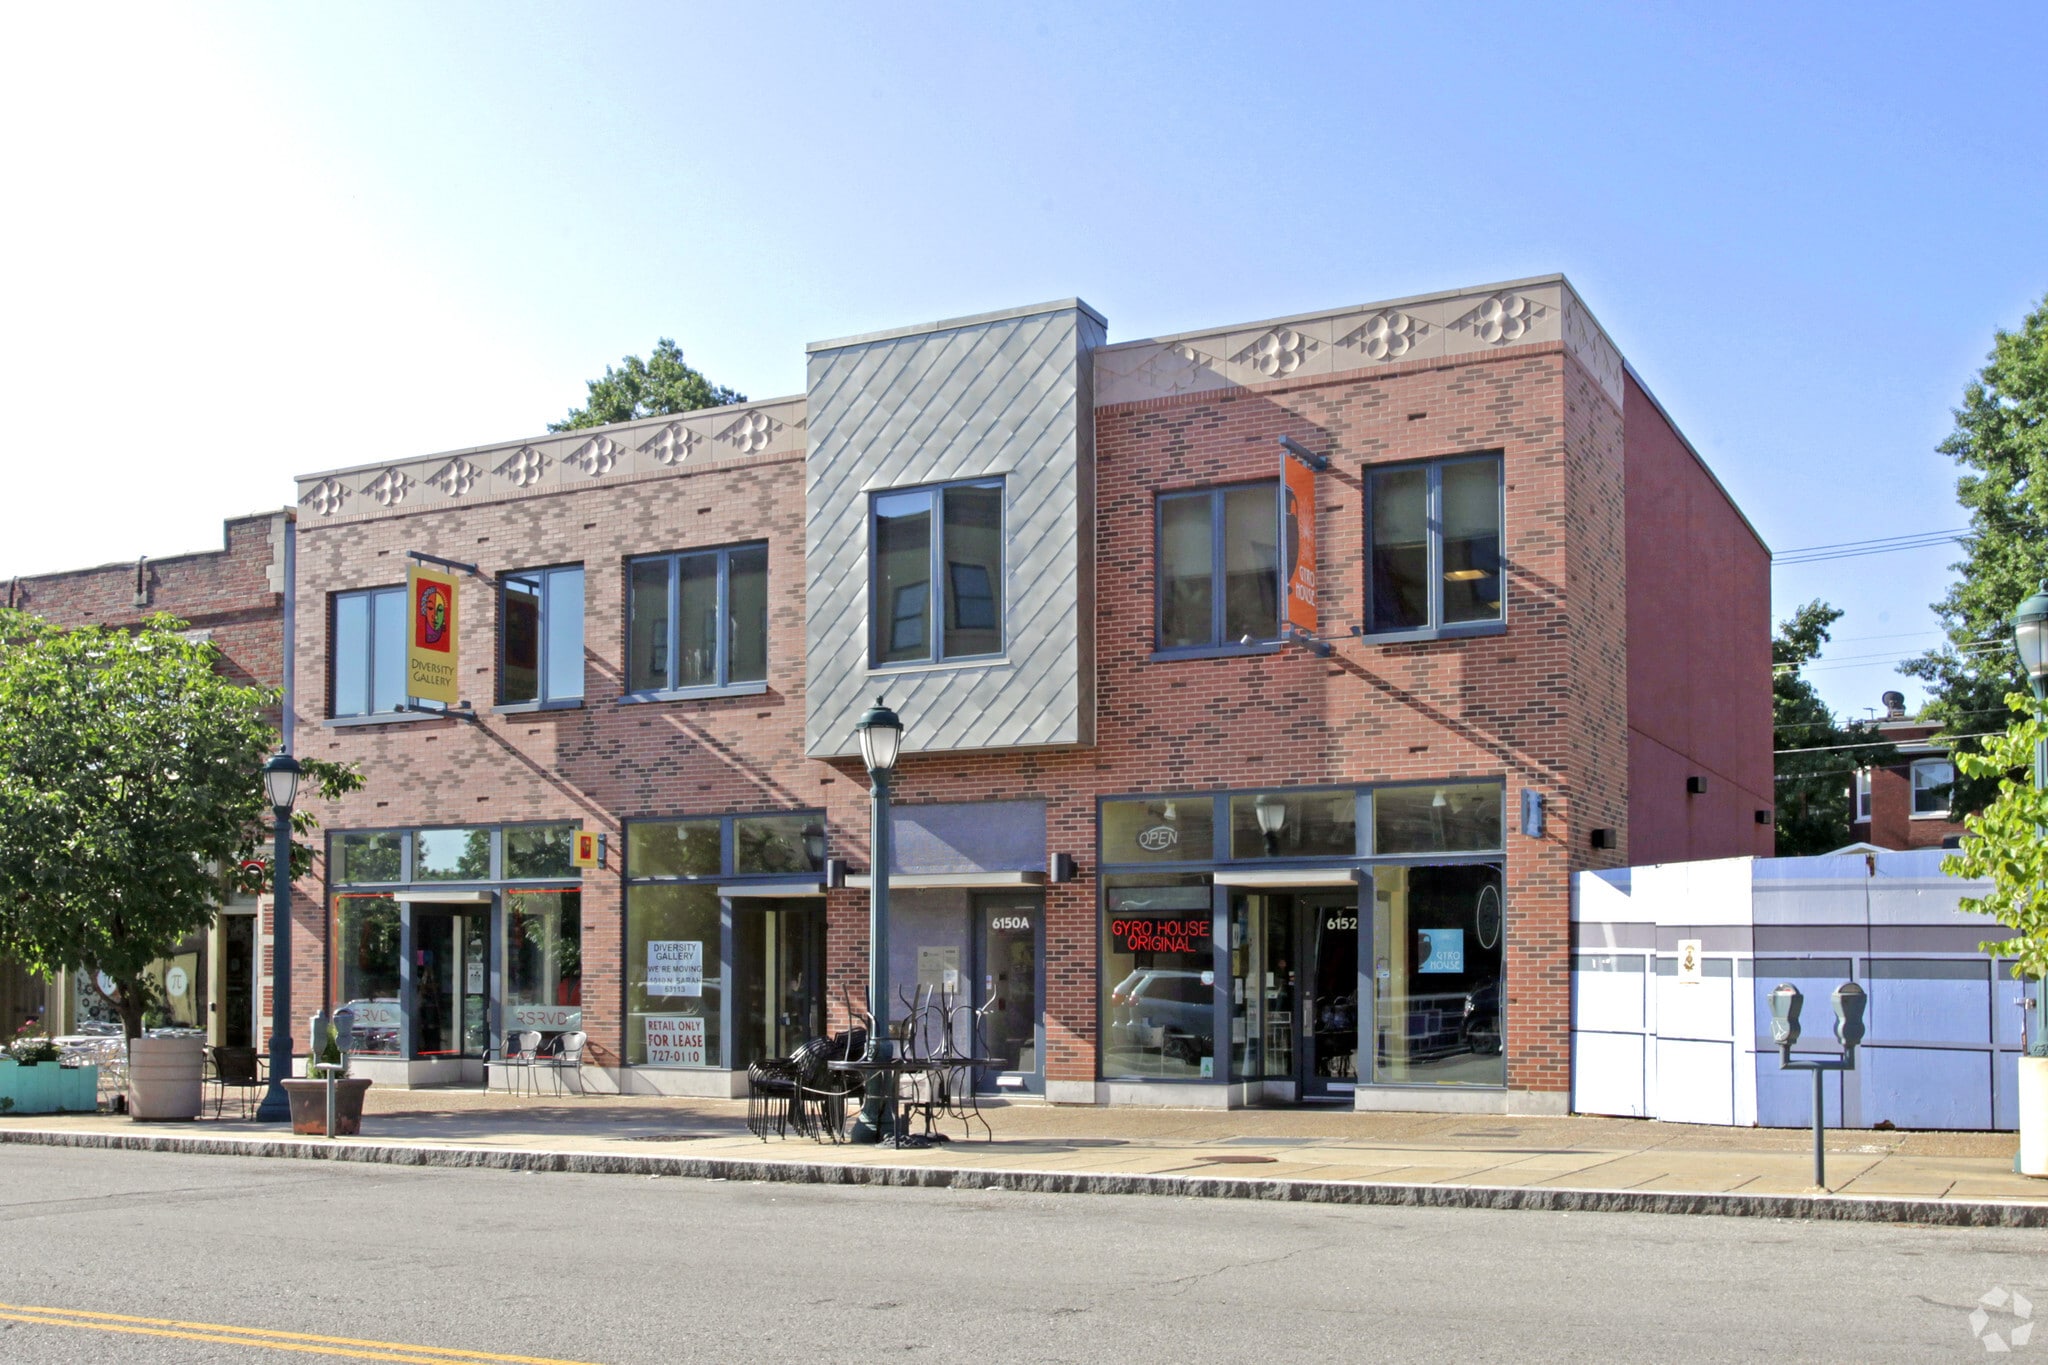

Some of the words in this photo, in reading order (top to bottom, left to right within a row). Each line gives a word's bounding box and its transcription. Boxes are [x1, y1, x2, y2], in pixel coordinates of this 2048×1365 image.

[411, 658, 454, 675] DIVERSITY
[413, 671, 451, 687] GALLERY
[1139, 831, 1178, 845] OPEN
[992, 916, 1030, 929] 6150A
[1112, 920, 1152, 936] GYRO
[1157, 920, 1209, 936] HOUSE
[1326, 917, 1357, 930] 6152
[653, 943, 697, 952] DIVERSITY
[1127, 935, 1196, 952] ORIGINAL
[655, 952, 694, 960] GALLERY
[673, 965, 702, 973] MOVING
[353, 1009, 390, 1022] SRVD
[517, 1011, 568, 1026] RSRVD
[648, 1020, 675, 1031] RETAIL
[678, 1020, 701, 1032] ONLY
[648, 1034, 669, 1047] FOR
[673, 1034, 703, 1048] LEASE
[652, 1050, 700, 1062] 727-0110
